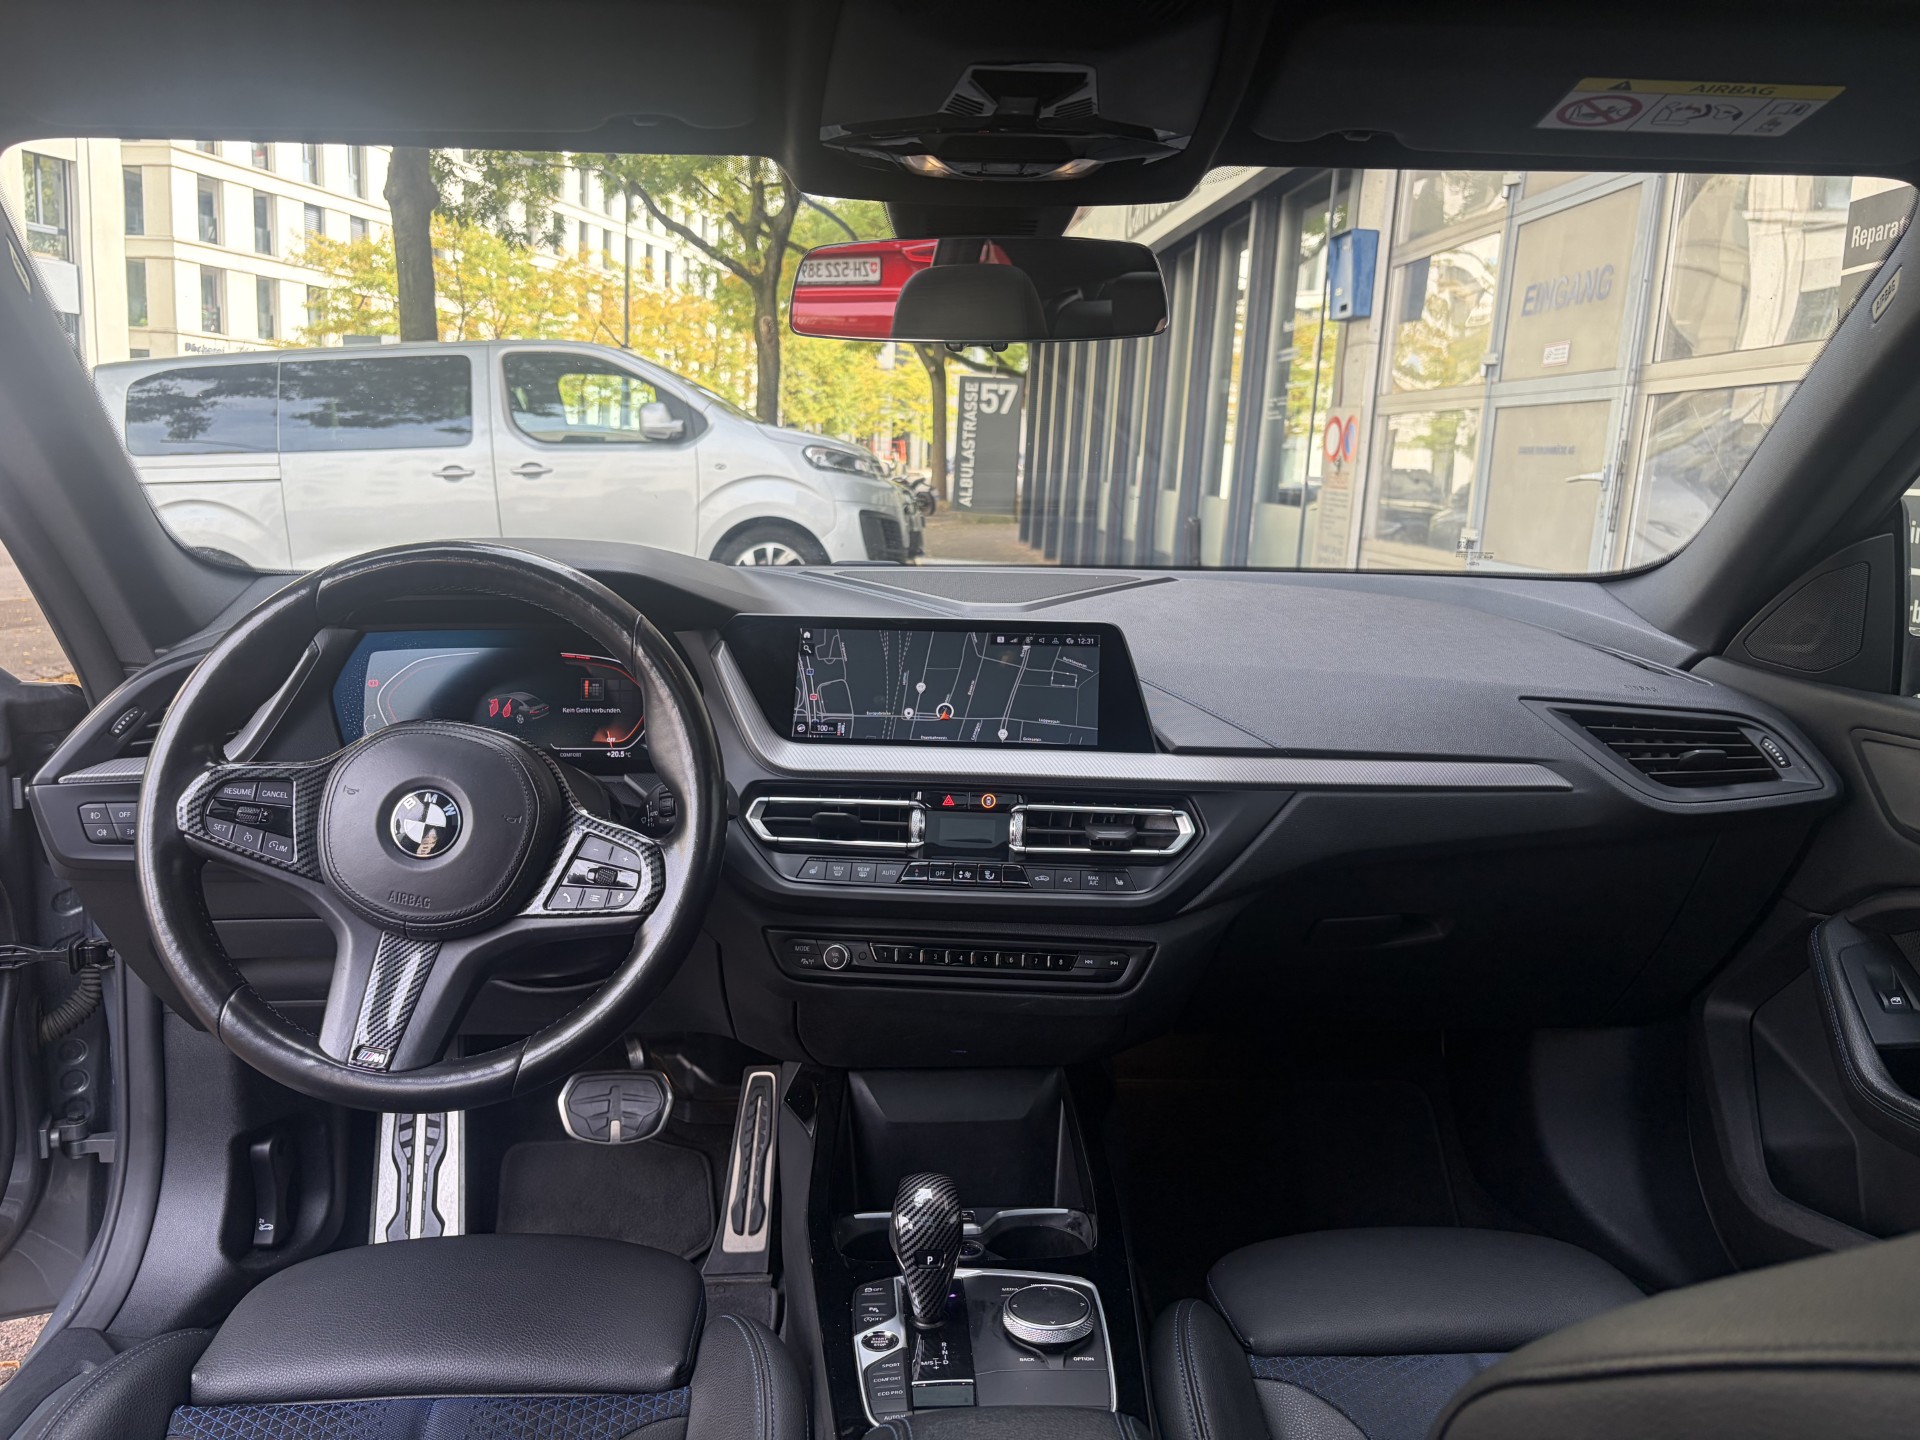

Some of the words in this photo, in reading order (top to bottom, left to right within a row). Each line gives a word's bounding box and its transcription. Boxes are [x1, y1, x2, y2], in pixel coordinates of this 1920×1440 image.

[1689, 84, 1776, 96] AIRBAG
[1521, 264, 1614, 317] EINGANG
[1875, 279, 1896, 313] AIRBAG
[980, 382, 1018, 414] 57
[958, 382, 980, 508] ALBULASTRASSE
[224, 787, 252, 795] RESUME
[262, 790, 288, 798] CANCEL
[403, 792, 457, 818] BMW
[213, 823, 228, 832] SET
[275, 844, 288, 852] LIM
[388, 890, 431, 908] AIRBAG
[926, 1256, 934, 1265] P
